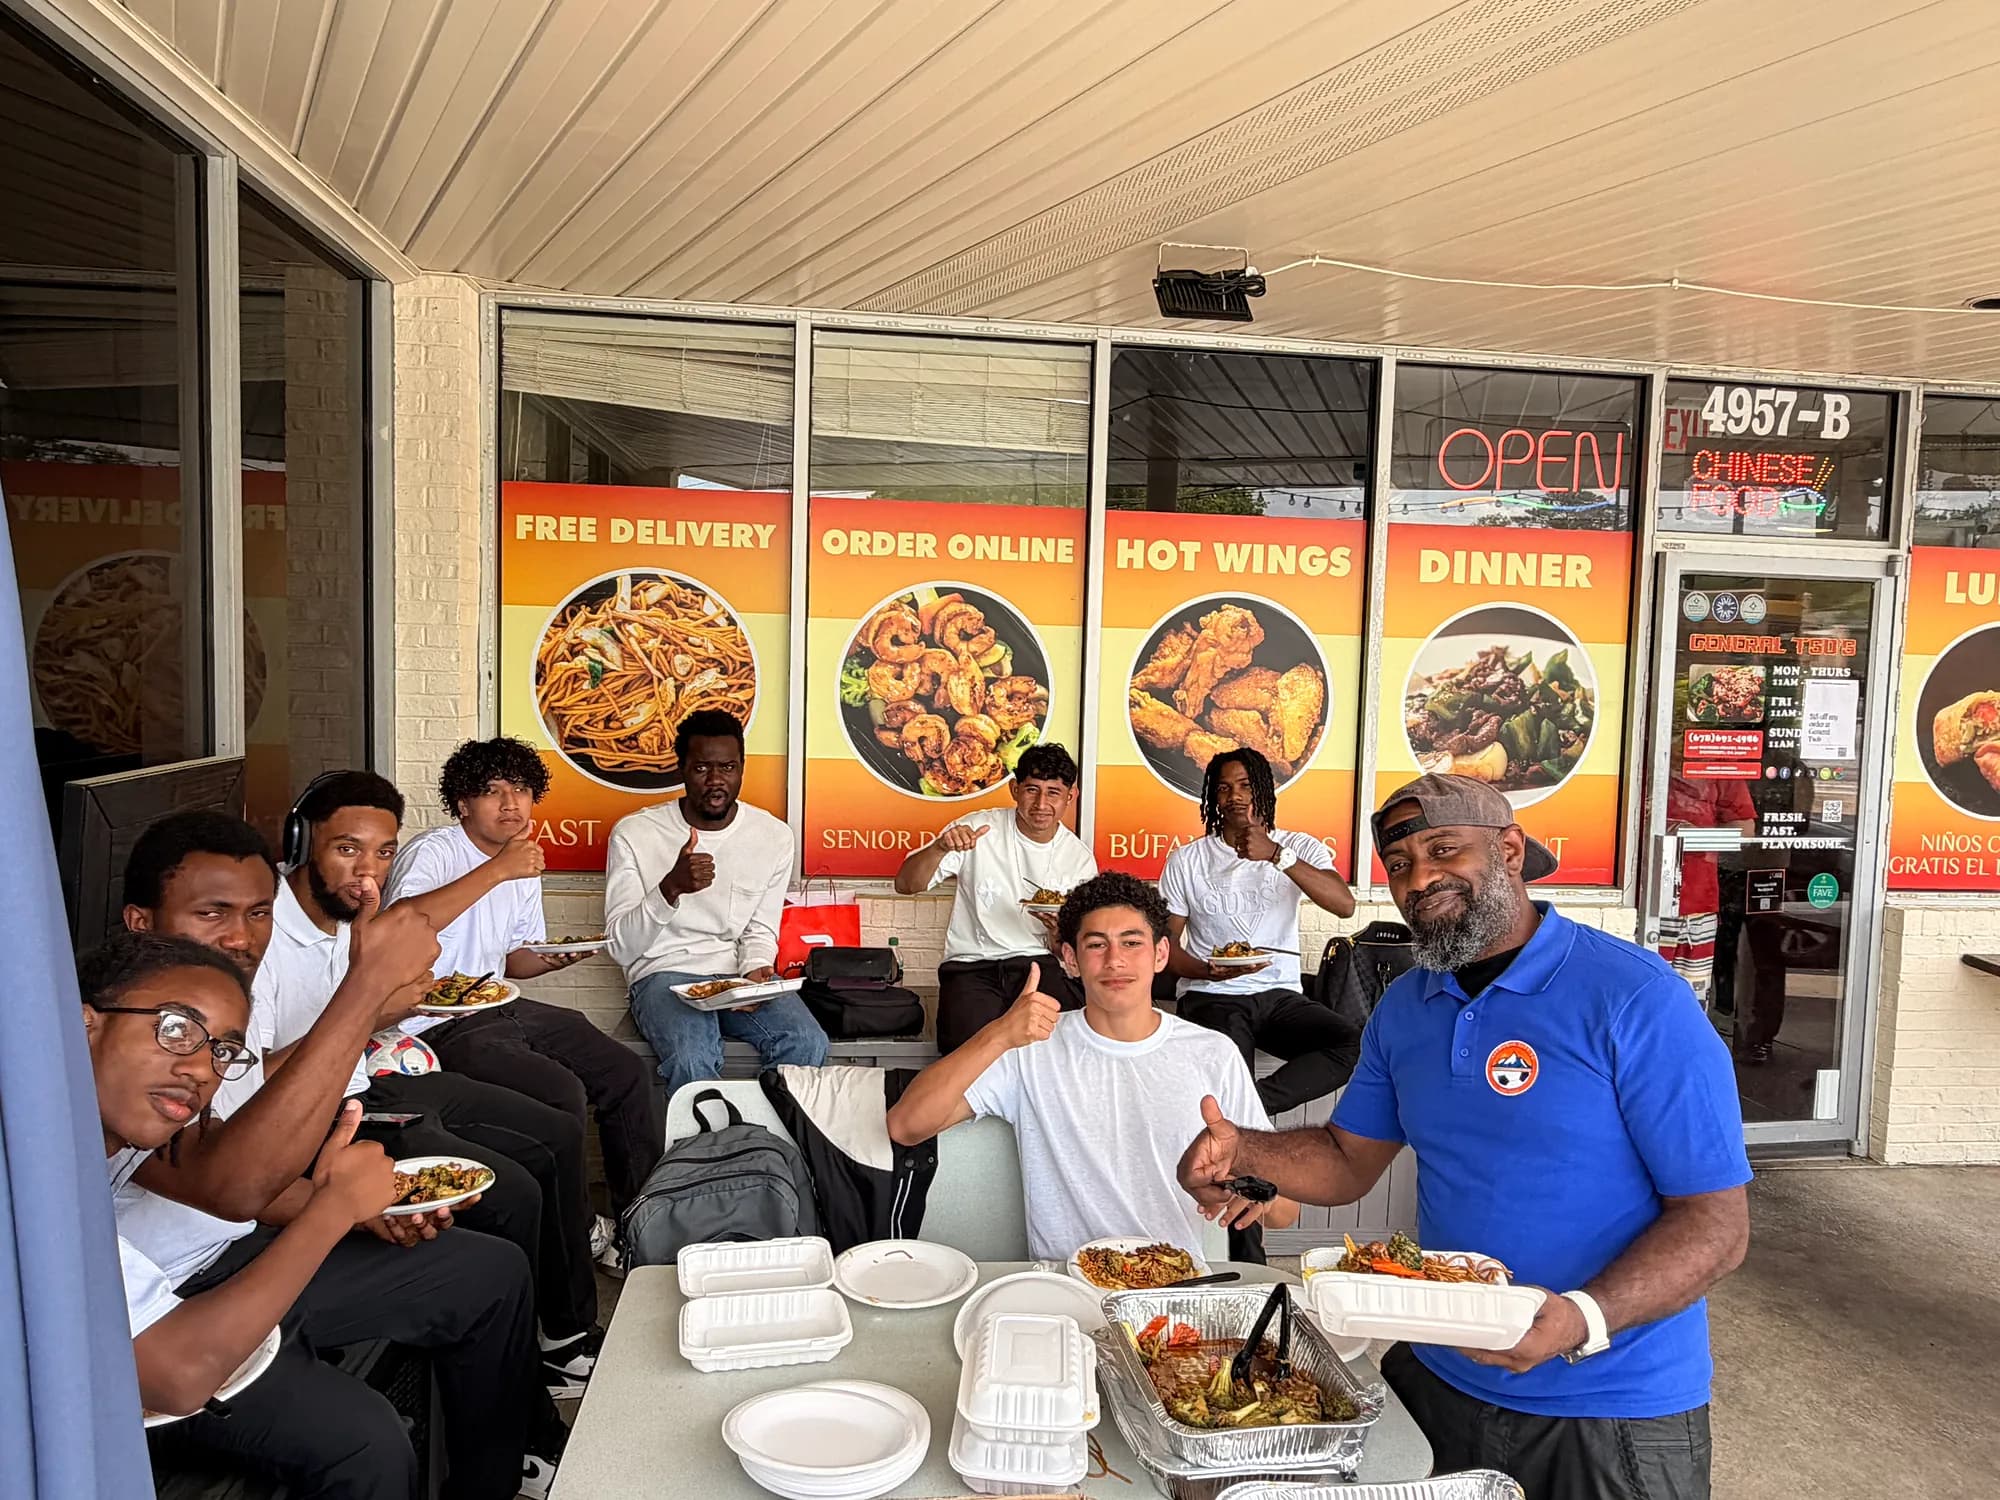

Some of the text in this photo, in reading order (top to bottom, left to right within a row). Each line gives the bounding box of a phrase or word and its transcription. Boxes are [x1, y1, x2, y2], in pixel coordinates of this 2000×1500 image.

[1701, 386, 1851, 440] 4957-B
[1438, 428, 1624, 493] OPEN
[1692, 449, 1816, 485] CHINESE
[1690, 483, 1780, 517] FOOD
[515, 514, 777, 550] FREE DELIVERY
[822, 528, 1075, 564] ORDER ONLINE
[1116, 538, 1353, 578] HOT WINGS
[1419, 549, 1593, 589] DINNER
[1944, 571, 2000, 606] LU
[1689, 634, 1787, 655] GENERAL
[1773, 665, 1800, 676] MON
[1811, 667, 1851, 677] THURS
[1771, 697, 1793, 707] FRI
[1768, 728, 1801, 738] SUND
[1762, 826, 1798, 836] FAST.
[1763, 812, 1806, 823] FRESH.
[529, 818, 602, 846] AST
[822, 829, 913, 850] SENIOR
[1109, 829, 1194, 859] BÚFA
[1921, 831, 1983, 853] NIÑOS
[1889, 856, 1961, 875] GRATIS
[1966, 857, 1991, 876] EL
[1813, 888, 1833, 897] FAVE
